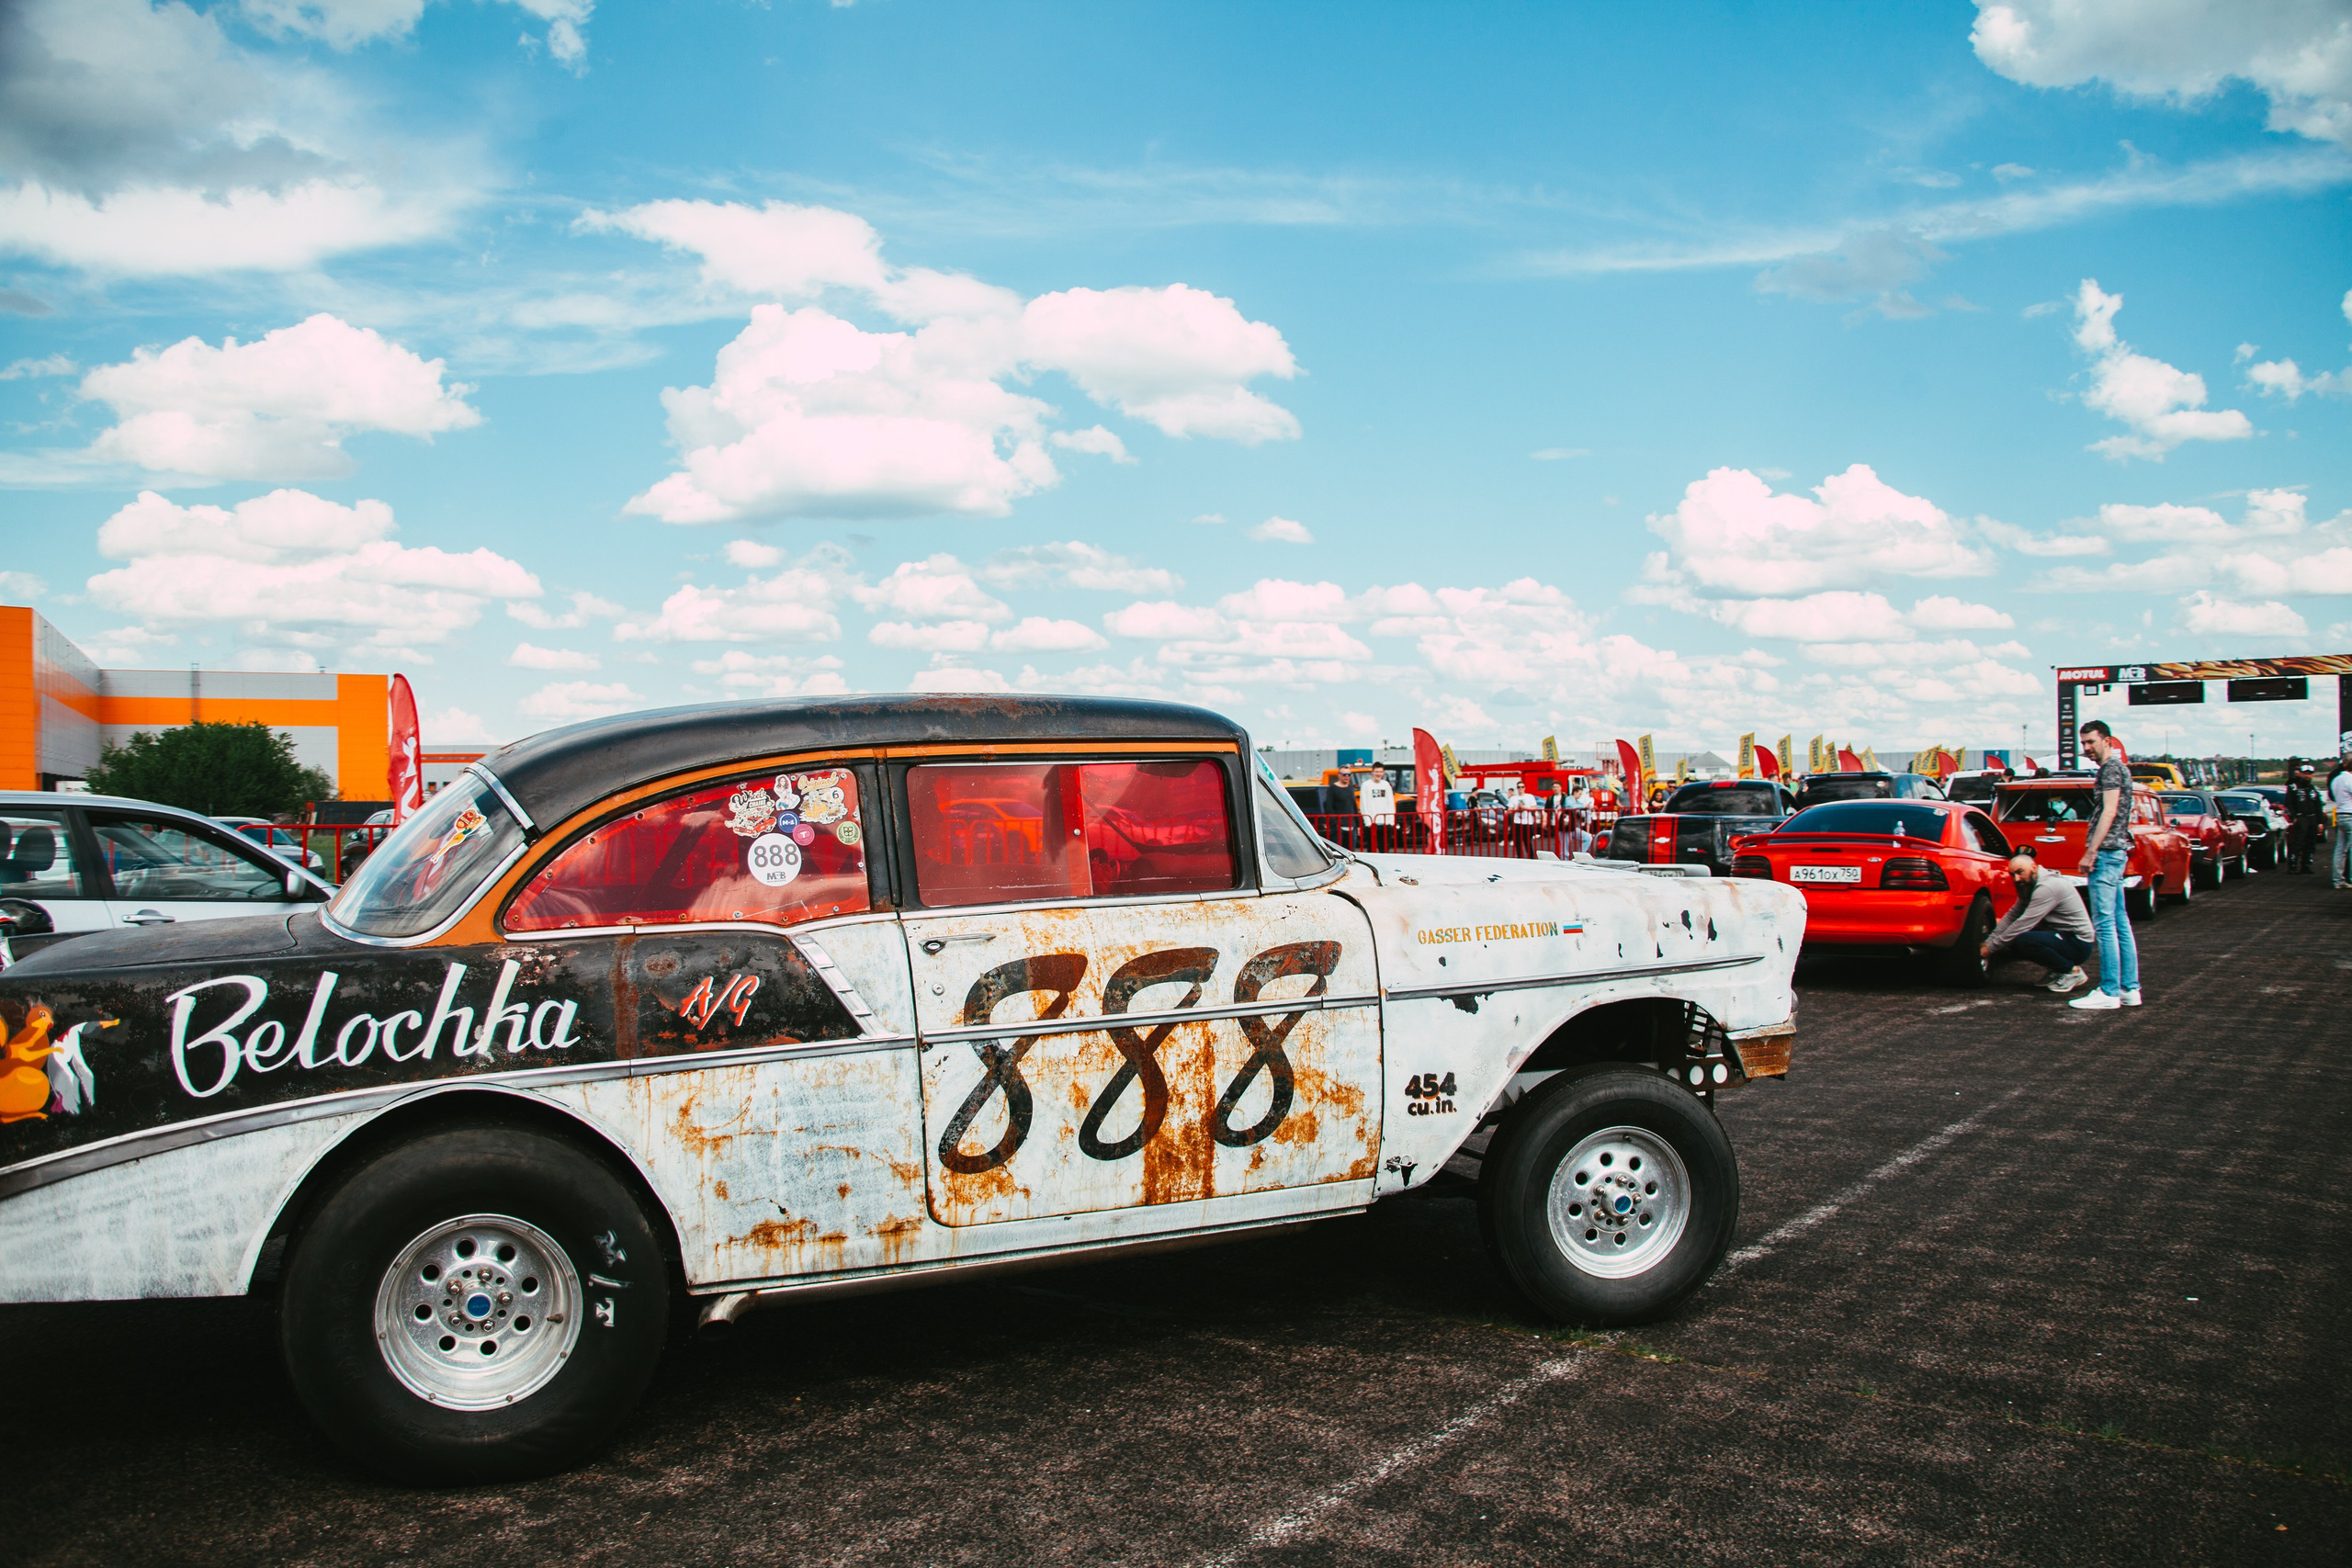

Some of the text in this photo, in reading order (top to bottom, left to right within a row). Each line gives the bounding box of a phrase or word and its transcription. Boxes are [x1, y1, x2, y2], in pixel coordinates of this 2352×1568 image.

[2059, 669, 2106, 680] MOTUL
[753, 843, 799, 868] 888
[1840, 868, 1860, 877] 750
[1418, 921, 1559, 944] GASSER FEDERATION
[679, 973, 761, 1031] A/G
[165, 959, 581, 1098] Belochka
[938, 940, 1342, 1175] 888
[1405, 1071, 1457, 1100] 454
